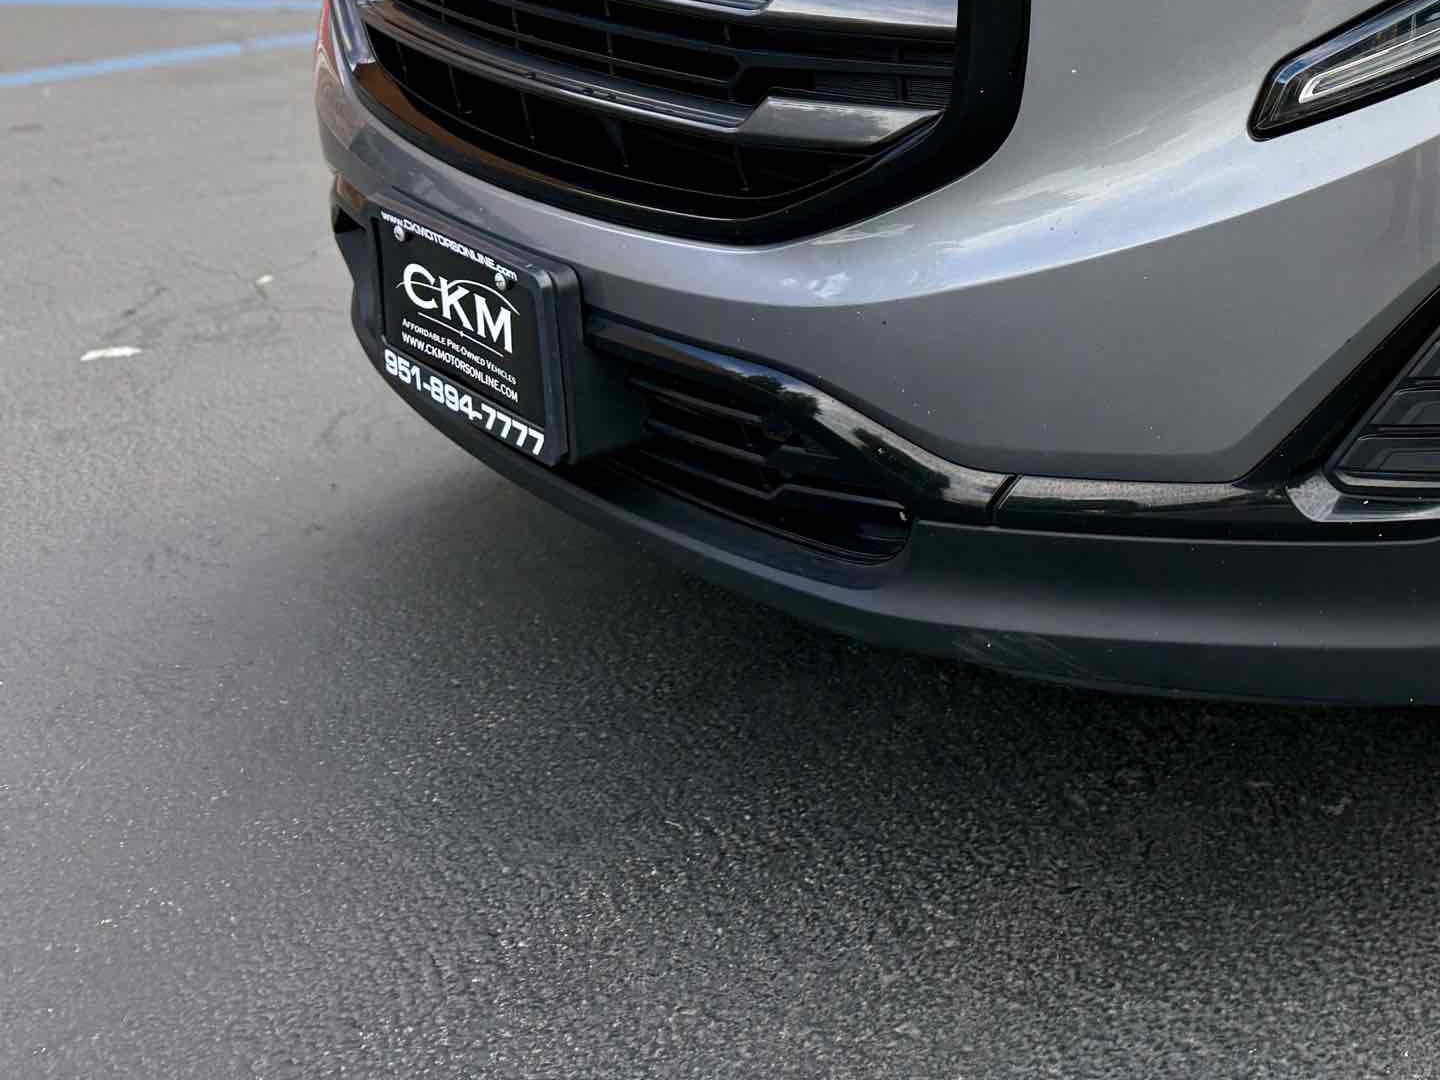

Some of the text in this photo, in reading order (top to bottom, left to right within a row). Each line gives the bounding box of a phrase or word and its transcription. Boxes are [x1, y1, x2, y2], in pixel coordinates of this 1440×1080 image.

[402, 263, 513, 354] CKM
[402, 318, 447, 345] AFFORDABLE
[384, 348, 545, 456] 951-894-7777
[401, 331, 518, 403] WWW.CKMOTORSONLINE.COM
